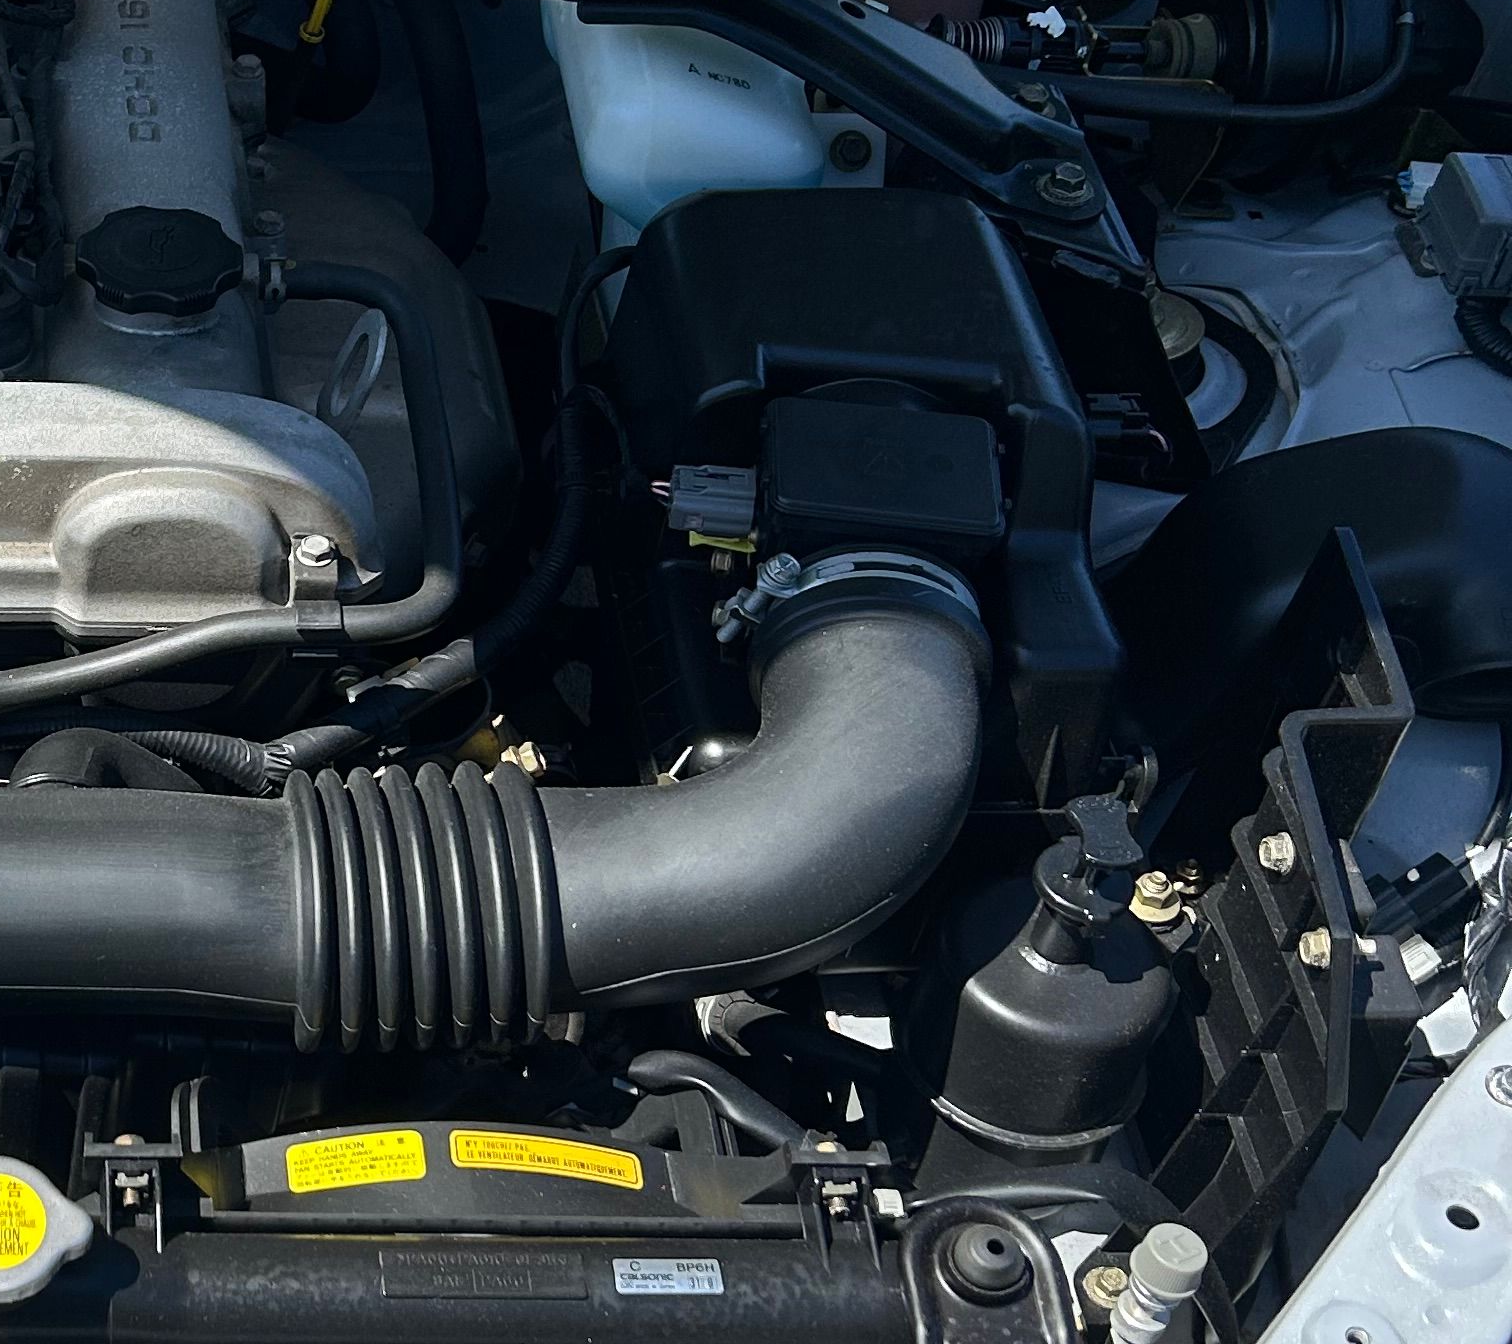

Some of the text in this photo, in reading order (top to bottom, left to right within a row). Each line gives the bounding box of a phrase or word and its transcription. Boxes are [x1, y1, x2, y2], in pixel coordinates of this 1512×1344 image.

[121, 45, 162, 143] DOHC
[314, 1141, 365, 1155] CAUTION
[293, 1150, 373, 1166] KEEP HANDS AWAY
[294, 1165, 311, 1174] FAN
[314, 1161, 345, 1171] STARTS
[348, 1152, 417, 1166] AUTOMATICALLY
[477, 1151, 524, 1163] VENTILATEUR
[676, 1262, 717, 1273] BP6H
